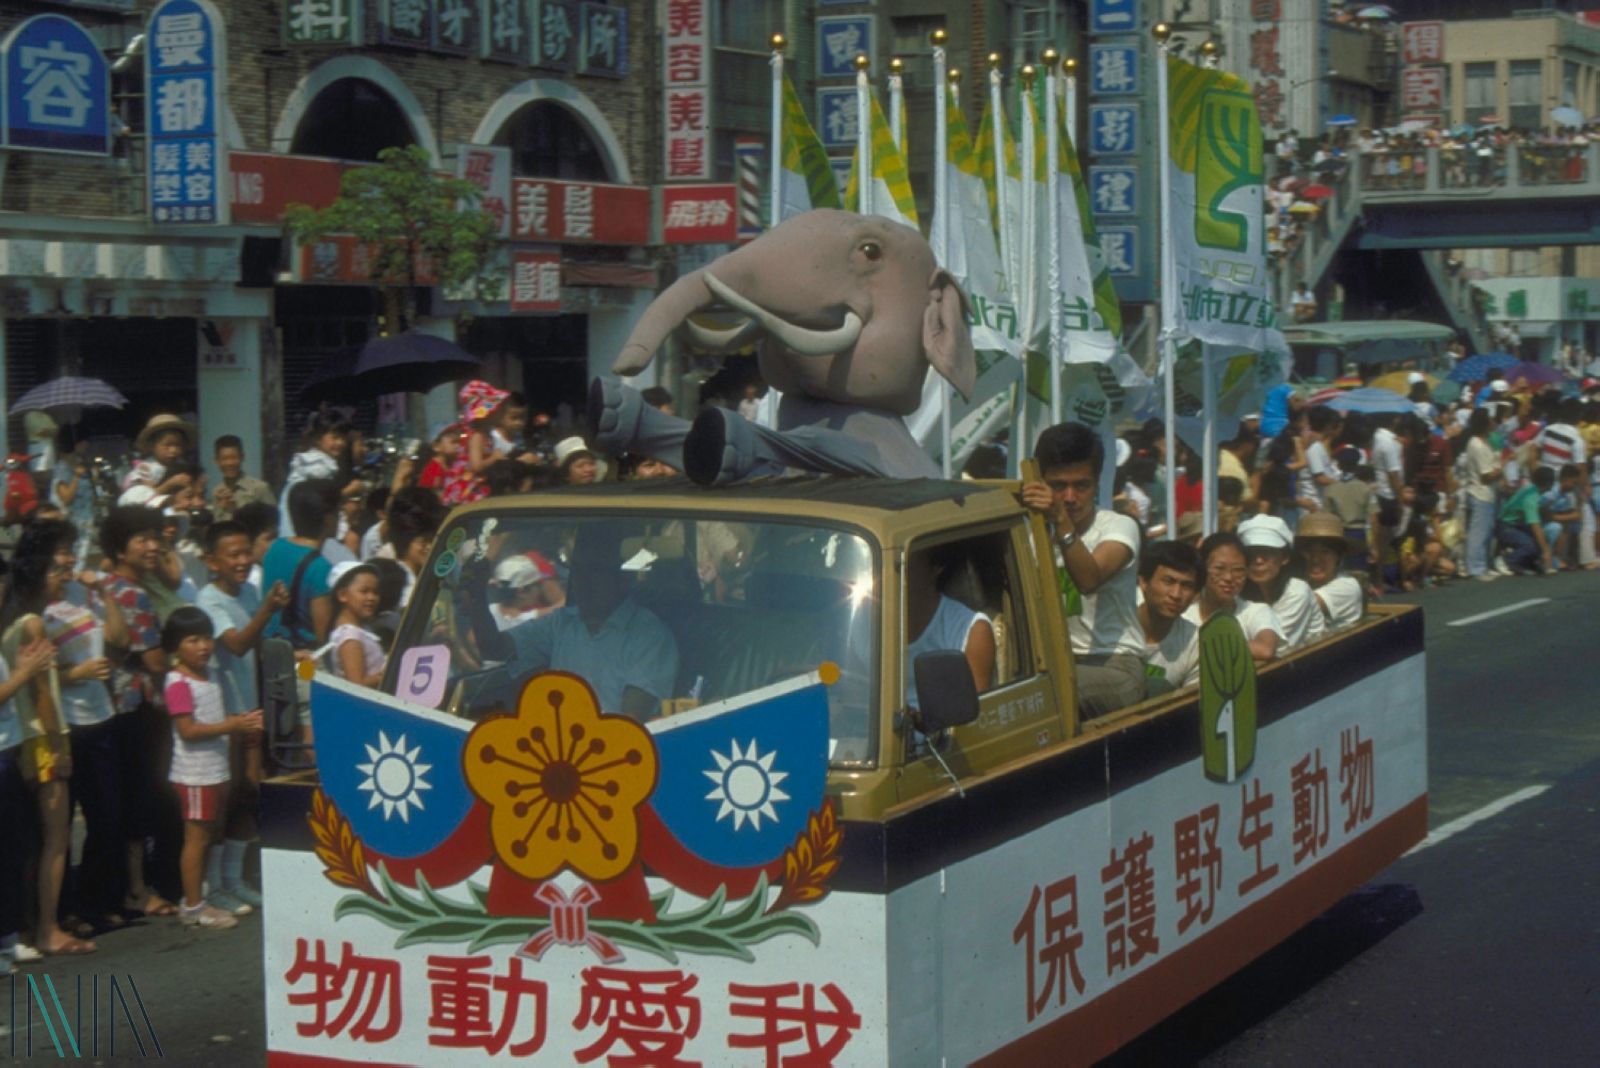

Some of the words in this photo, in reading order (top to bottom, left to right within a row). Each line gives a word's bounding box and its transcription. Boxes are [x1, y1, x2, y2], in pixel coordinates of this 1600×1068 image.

[288, 0, 348, 40] 科
[19, 40, 93, 127] 容
[155, 12, 207, 132] 曼都
[668, 0, 705, 177] 美容美髮
[185, 142, 212, 201] 美容
[516, 183, 594, 238] 美髮
[409, 655, 434, 695] 5
[1013, 724, 1374, 1024] 保護野生動物
